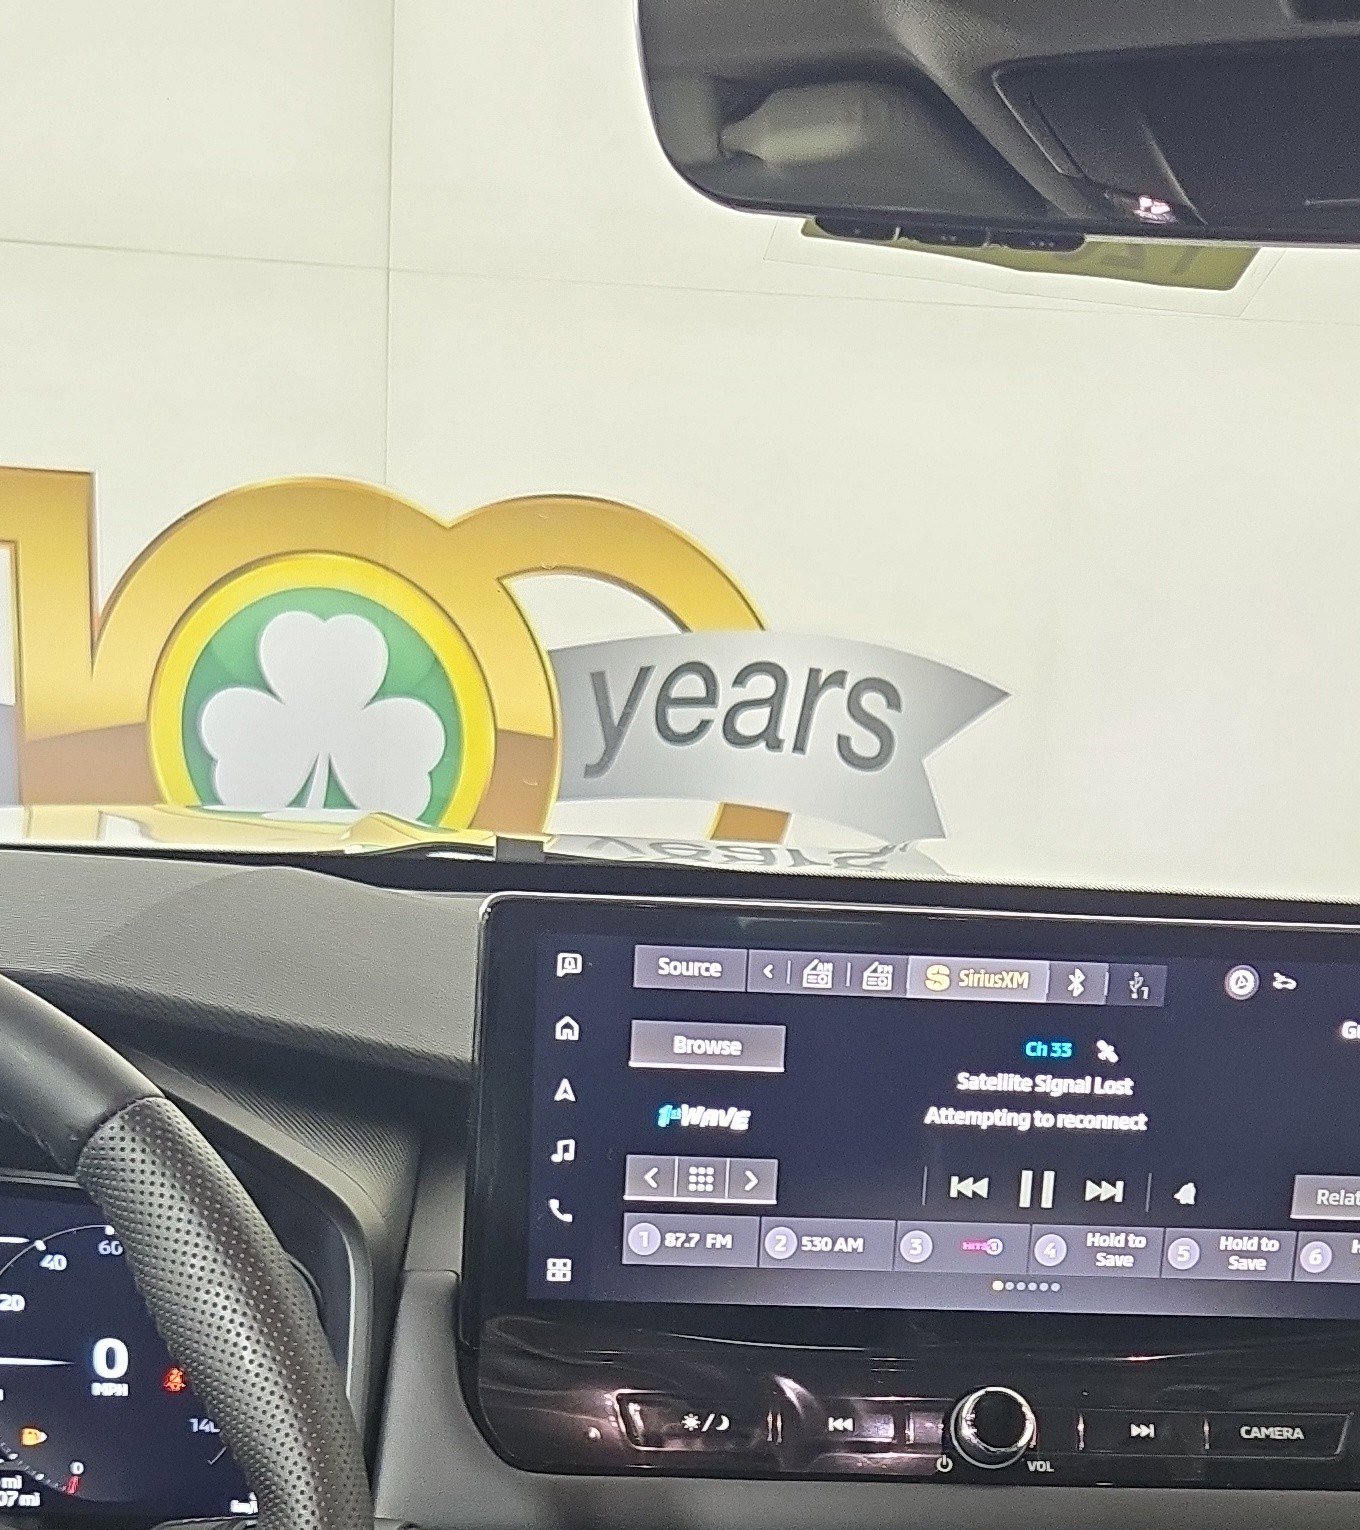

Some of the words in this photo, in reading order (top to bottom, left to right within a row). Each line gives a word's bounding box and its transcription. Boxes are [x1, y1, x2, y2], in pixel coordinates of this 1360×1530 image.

[584, 659, 902, 775] years
[658, 957, 722, 978] Source
[959, 969, 1029, 990] SiriusXM
[673, 1035, 742, 1056] Browse
[1025, 1040, 1048, 1057] Ch
[1050, 1041, 1072, 1058] 33
[956, 1072, 1032, 1092] Satellite
[1035, 1074, 1091, 1097] Signal
[1094, 1076, 1134, 1096] Lost
[923, 1106, 1030, 1131] Attempting
[1034, 1111, 1055, 1128] to
[1056, 1112, 1148, 1131] reconnect
[97, 1240, 124, 1256] 60
[664, 1233, 699, 1248] 87.7
[706, 1233, 733, 1250] FM
[774, 1235, 788, 1251] 2
[801, 1236, 833, 1251] 530
[834, 1237, 865, 1254] AM
[908, 1239, 923, 1255] 3
[1087, 1232, 1126, 1248] Hold
[1128, 1235, 1147, 1249] to
[1219, 1236, 1258, 1252] Hold
[1261, 1238, 1280, 1252] to
[1043, 1243, 1057, 1258] 4
[1177, 1246, 1190, 1262] 5
[1309, 1249, 1323, 1265] 6
[41, 1254, 67, 1271] 40
[1095, 1252, 1134, 1268] Save
[1228, 1255, 1267, 1271] Save
[92, 1337, 129, 1379] 0
[91, 1382, 129, 1397] MPH
[1240, 1426, 1305, 1441] CAMERA
[1027, 1460, 1055, 1473] VOL
[0, 1475, 22, 1489] mi
[19, 1493, 40, 1507] mi
